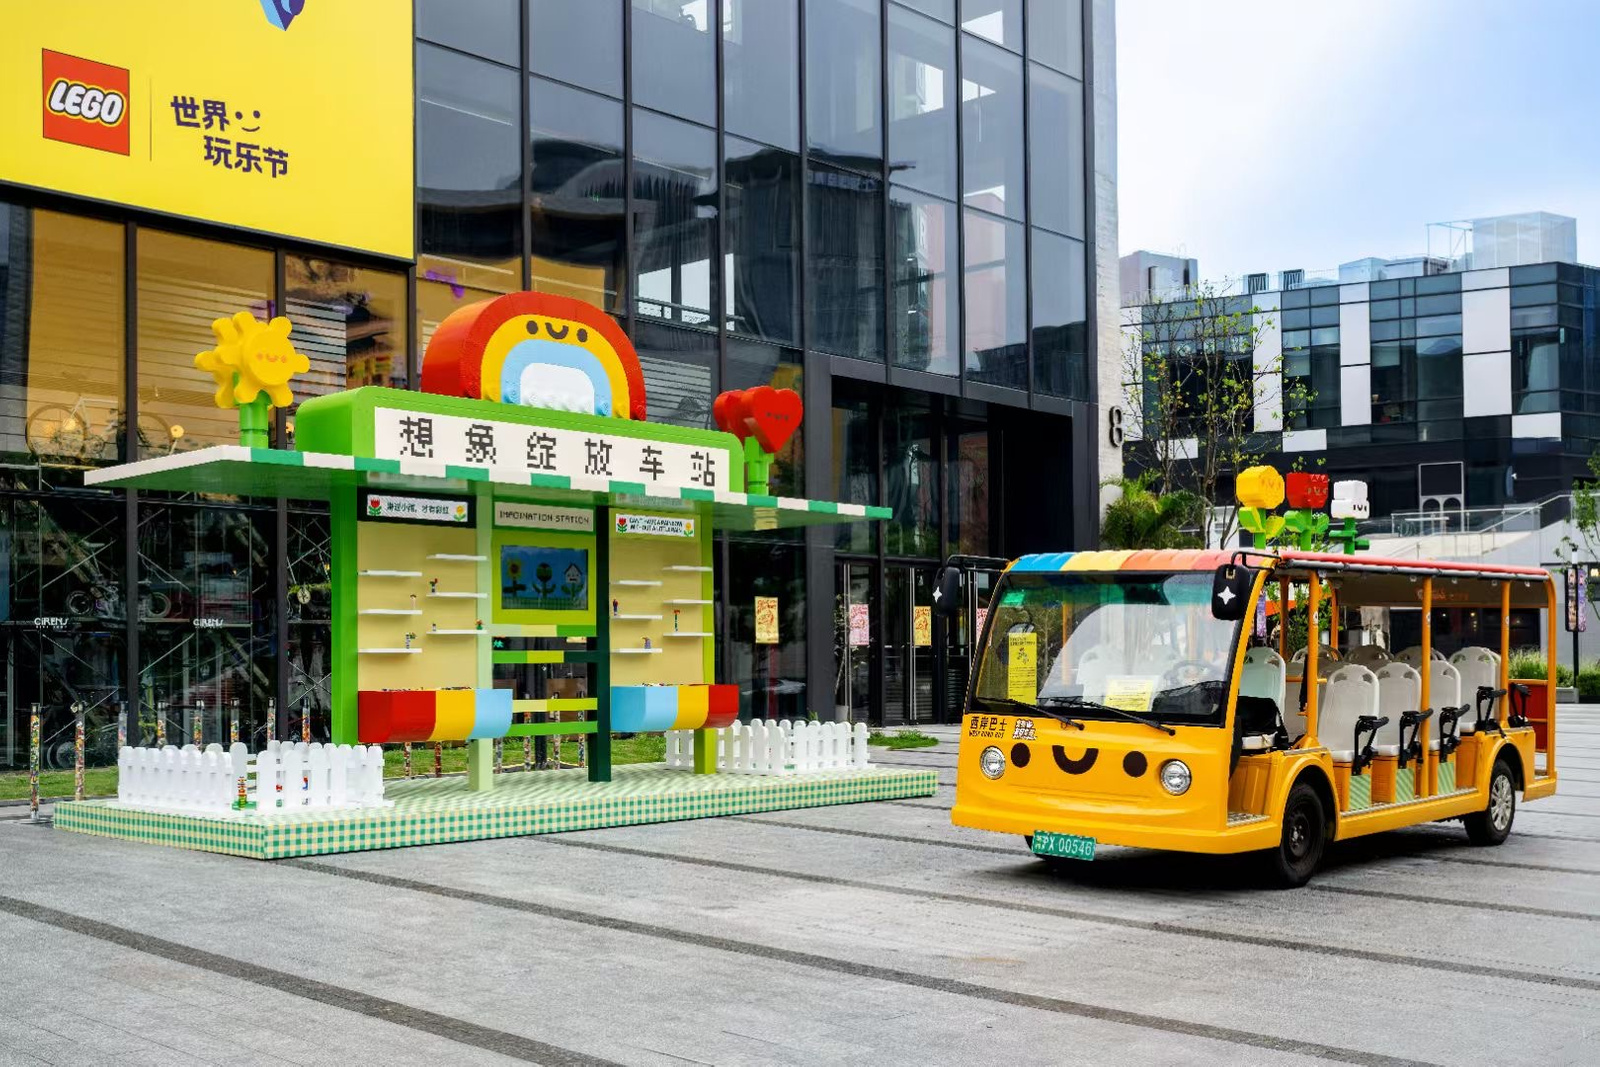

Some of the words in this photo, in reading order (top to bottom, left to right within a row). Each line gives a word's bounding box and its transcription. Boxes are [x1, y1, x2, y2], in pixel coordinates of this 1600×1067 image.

[49, 80, 124, 124] LEGO
[170, 95, 230, 132] 世界
[203, 135, 289, 179] 玩乐节
[399, 416, 716, 487] 想象绽放车站
[970, 716, 1007, 732] 西岸巴士
